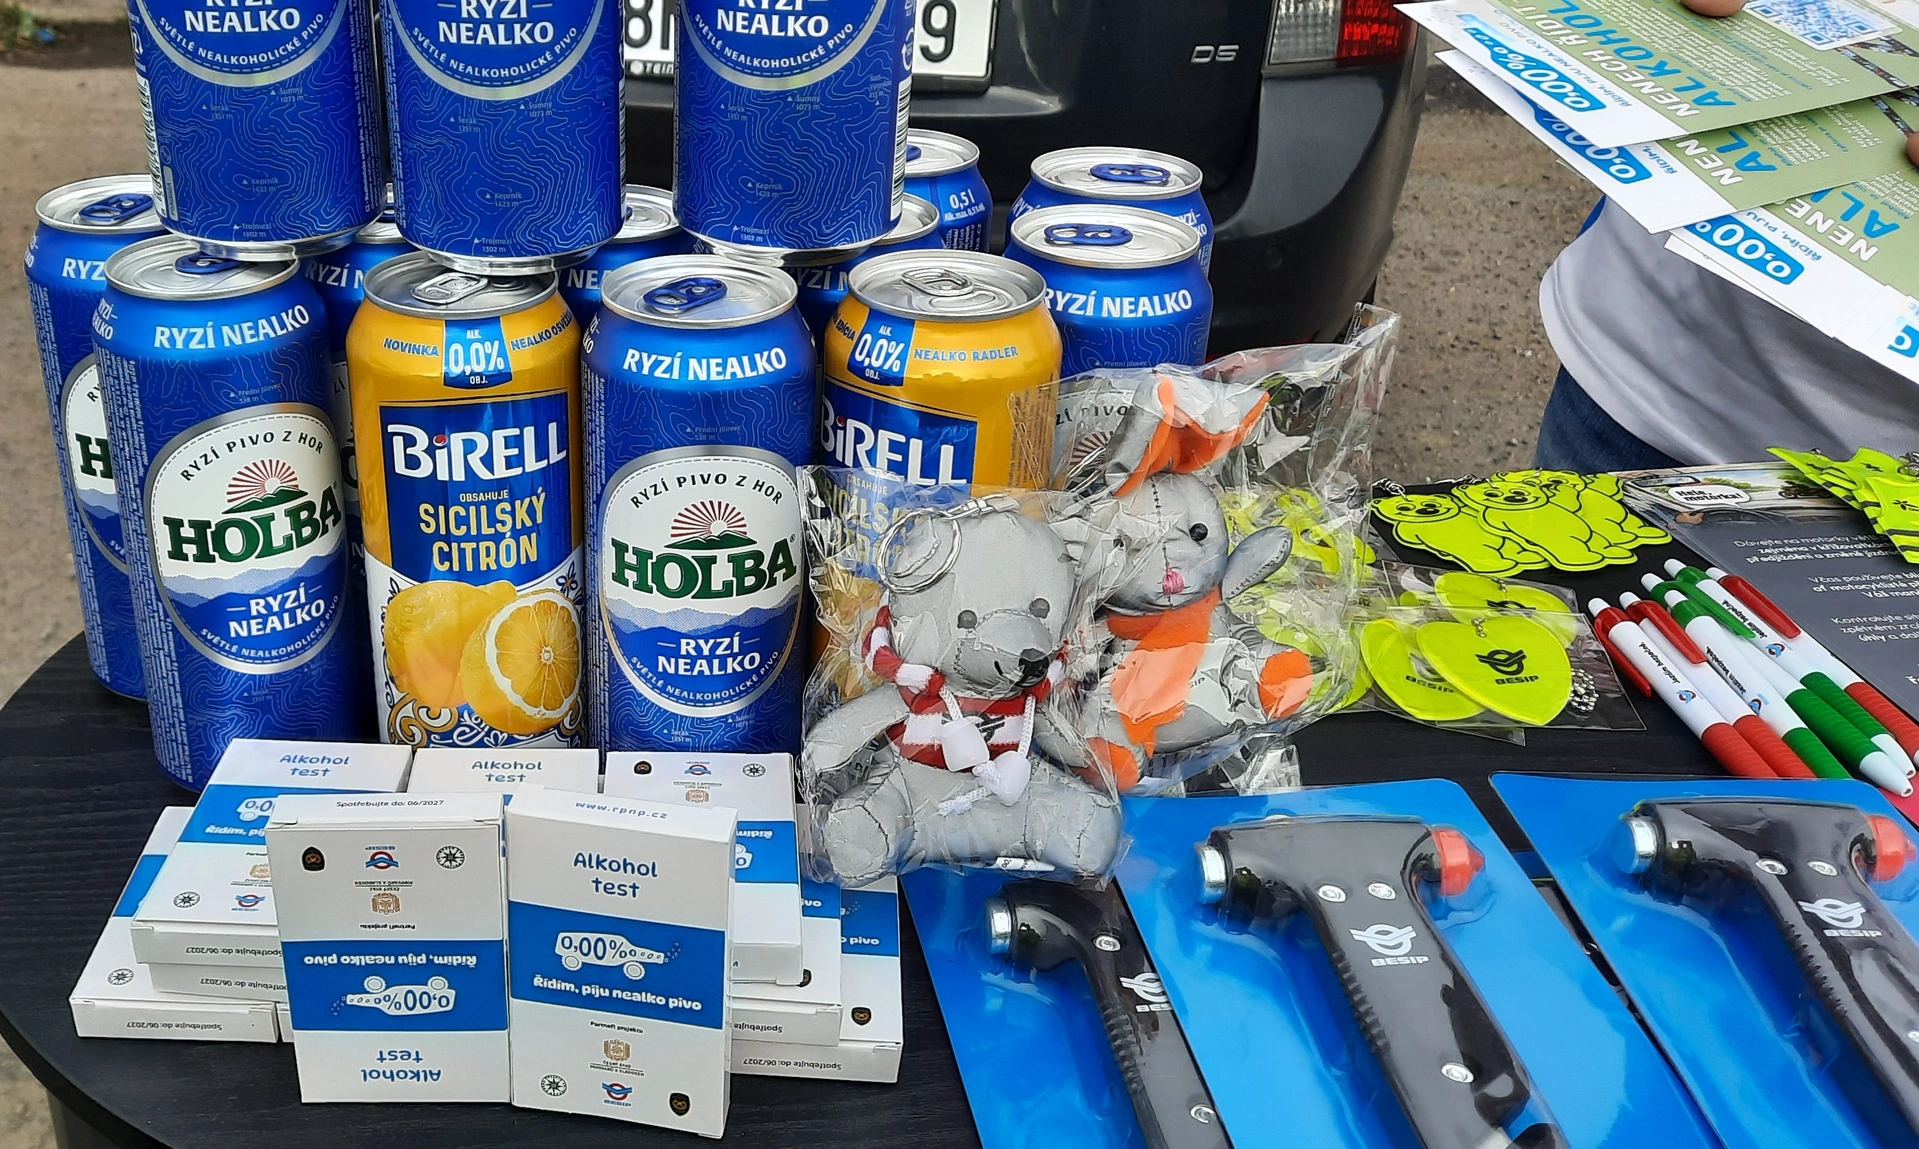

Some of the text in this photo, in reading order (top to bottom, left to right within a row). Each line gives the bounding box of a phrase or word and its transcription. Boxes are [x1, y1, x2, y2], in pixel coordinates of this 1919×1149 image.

[184, 8, 300, 32] NEALKO
[717, 9, 829, 37] NEALKO
[160, 13, 325, 65] SVĚTLÉ NEALKOHOLICKÉ PIVO
[438, 20, 554, 45] NEALKO
[694, 13, 854, 68] SVĚTLÉ NEALKOHOLICKÉ PIVO
[412, 27, 577, 78] SVĚTLÉ NEALKOHOLICKÉ PIVO
[1190, 44, 1240, 64] D5
[1526, 33, 1576, 72] NEALKO
[1548, 0, 1737, 106] ALKOHOL
[1574, 69, 1599, 86] PIJU
[1582, 49, 1700, 118] NENECH
[1597, 83, 1633, 108] ŘÍDÍM,
[950, 191, 969, 210] 0,5
[1745, 210, 1780, 234] PIJU
[1782, 231, 1822, 262] ŘÍDÍM,
[62, 257, 106, 280] RYZ
[305, 262, 349, 288] RYZÍ
[1045, 288, 1193, 318] RYZÍ NEALKO
[154, 305, 310, 349] RYZÍ NEALKO
[466, 329, 483, 340] ALK.
[383, 337, 439, 357] NOVINKA
[510, 328, 551, 351] NEALKO
[449, 340, 505, 375] 0,0%
[622, 347, 787, 381] RYZÍ NEALKO
[853, 333, 905, 373] 0,0%
[913, 346, 1019, 362] NEALKO RADLER
[469, 375, 489, 385] OBJ.
[865, 368, 881, 381] OBJ.
[180, 430, 323, 481] RYZÍ PIVO Z HOR
[459, 489, 509, 503] OBSAHUJE
[630, 473, 783, 509] RYZÍ PIVO Z HOR
[419, 486, 546, 536] SICILSKÝ
[163, 486, 341, 563] HOLBA
[432, 531, 538, 572] CITRÓN
[610, 537, 797, 600] HOLBA
[249, 582, 306, 616] RYZÍ
[200, 595, 339, 657] SVĚTLÉ NEALKOHOLICKÉ PIVO
[229, 599, 325, 638] NEALKO
[680, 631, 740, 656] RYZÍ
[630, 651, 780, 701] SVĚTLÉ NEALKOHOLICKÉ PIVO
[657, 652, 761, 676] NEALKO
[1495, 674, 1539, 685] BESIP
[279, 754, 350, 766] Alkohol
[290, 767, 331, 777] test
[471, 760, 543, 771] Alkohol
[485, 772, 527, 783] test
[336, 800, 389, 808] Spotřebujte
[407, 799, 444, 807] 06/2027
[575, 800, 668, 820] www.rpnp.cz
[205, 824, 246, 837] Řídím,
[573, 851, 658, 878] Alkohol
[591, 876, 640, 899] test
[849, 935, 880, 946] pivo
[1823, 929, 1882, 938] BESIP
[185, 947, 219, 955] 06/2027
[304, 953, 477, 968] Řídím, piju nealko pivo
[1371, 955, 1429, 967] BESIP
[533, 974, 703, 1011] Řídím, piju nealko pivo
[127, 1021, 222, 1031] Spotřebujte do: 06/2027
[733, 1021, 783, 1033] Spotřebujte
[376, 1049, 424, 1064] test
[743, 1057, 842, 1071] Spotřebujte do: 06/2027
[360, 1069, 442, 1083] Alkohol
